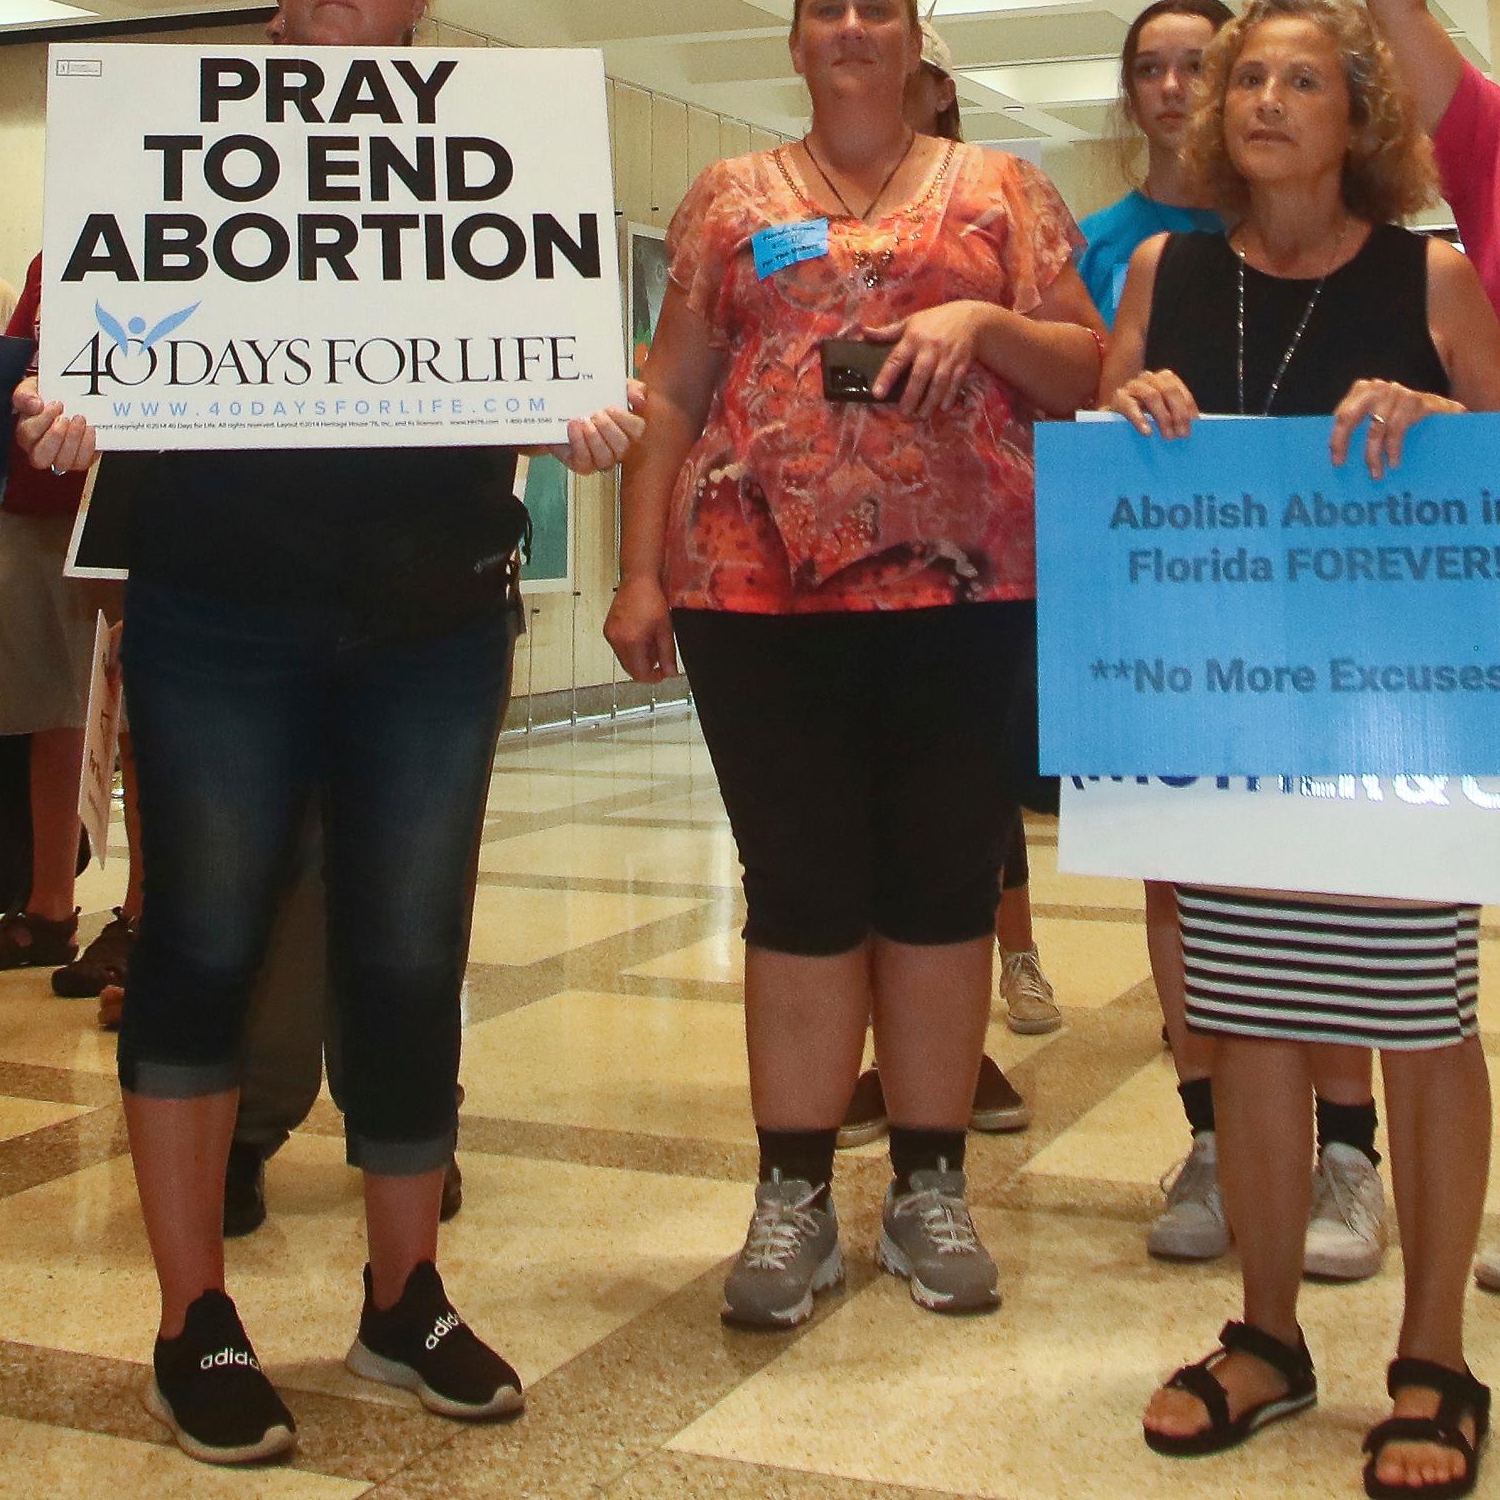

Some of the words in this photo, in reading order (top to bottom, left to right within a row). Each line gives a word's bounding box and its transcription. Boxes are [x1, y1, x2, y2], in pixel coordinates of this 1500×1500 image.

[199, 58, 458, 124] PRAY
[144, 134, 280, 202] TO
[307, 136, 514, 202] END
[60, 213, 601, 283] ABORTION
[60, 331, 158, 397] 40
[165, 337, 312, 386] DAYS
[321, 337, 458, 385] FOR
[112, 397, 546, 417] WWW.40DAYSFORLIFE.COM
[1109, 492, 1268, 531] Abolish
[1280, 490, 1470, 528] Abortion
[1128, 547, 1273, 585] Florida
[1205, 658, 1316, 693] More
